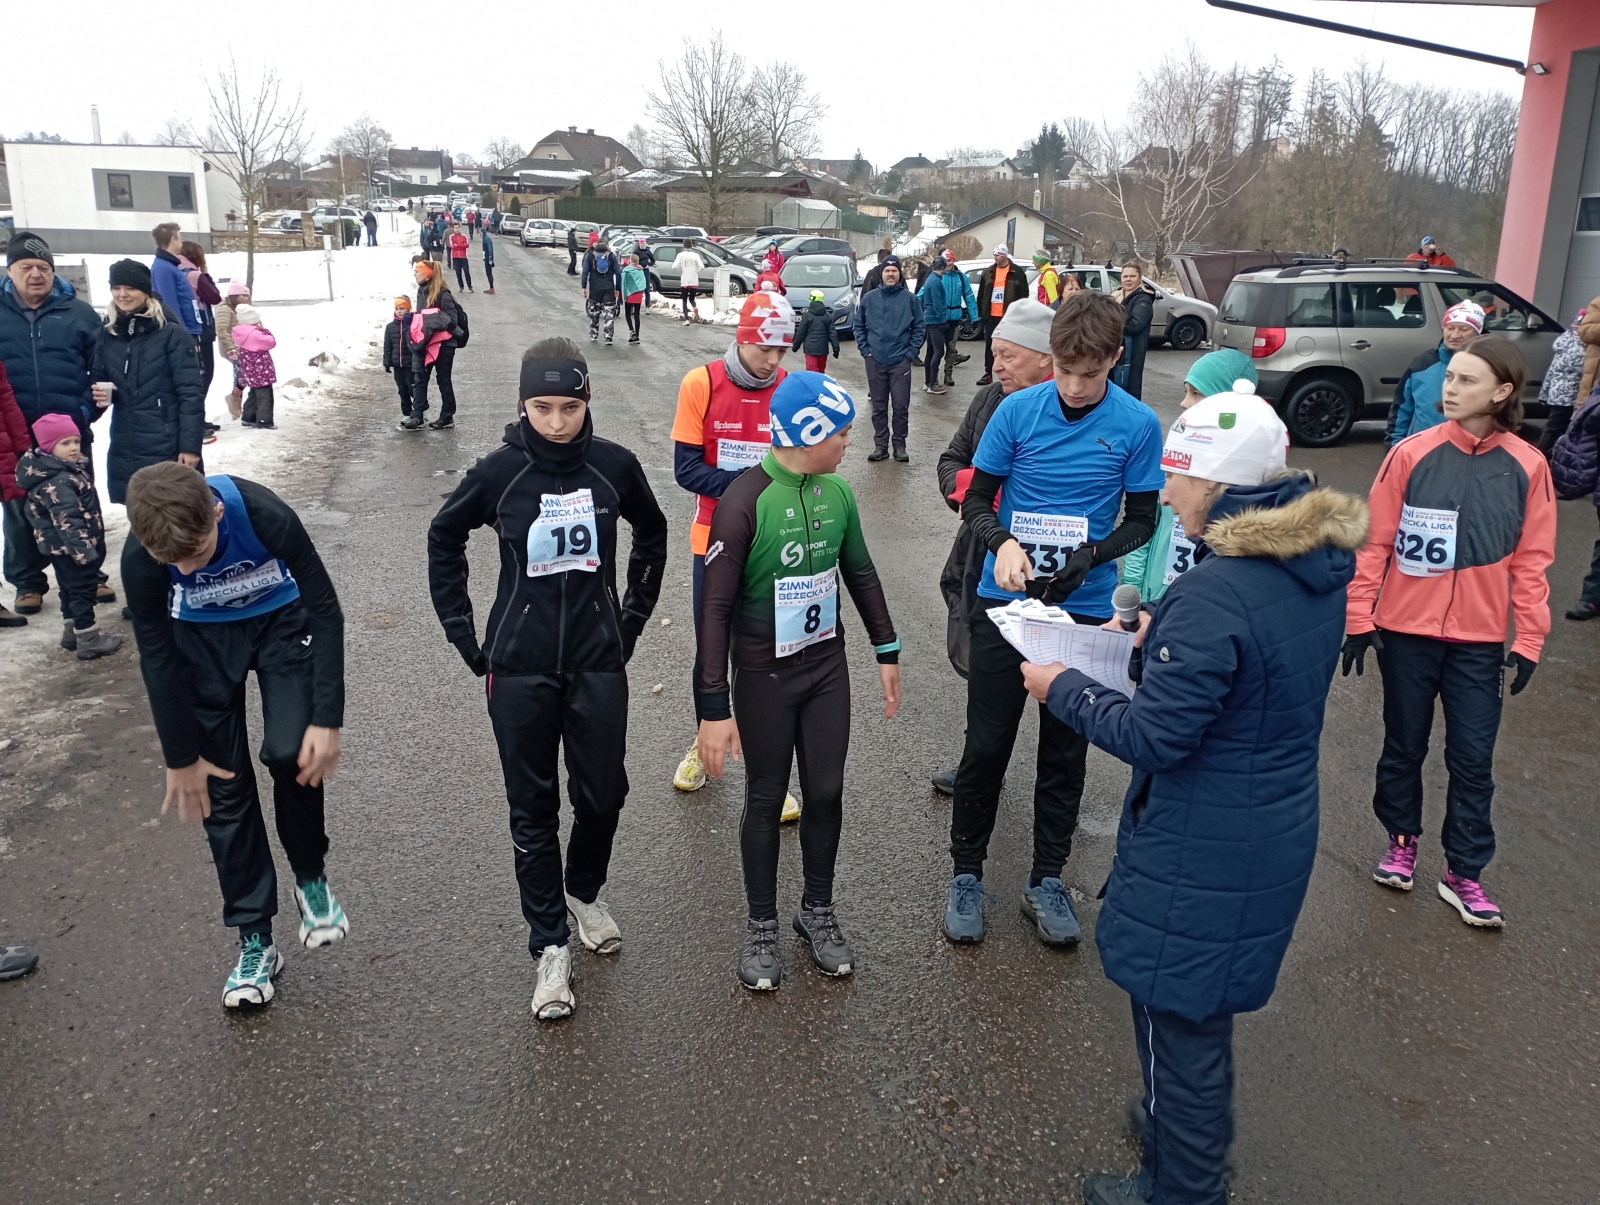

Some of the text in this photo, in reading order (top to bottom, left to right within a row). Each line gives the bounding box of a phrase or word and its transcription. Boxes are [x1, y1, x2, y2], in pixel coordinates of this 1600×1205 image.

[720, 441, 747, 452] ZIMNÍ
[719, 449, 759, 461] BĚŽECKÁ
[1014, 515, 1043, 527] ZIMNÍ
[1431, 522, 1454, 531] LIGA
[1012, 526, 1084, 539] BĚŽECKÁ LIGA
[550, 524, 592, 556] 19
[805, 540, 828, 551] SPORT
[1396, 528, 1448, 565] 326
[812, 546, 839, 559] MTB TEAM
[190, 584, 250, 605] BĚŽECKÁ
[251, 574, 280, 589] LIGA
[778, 579, 813, 591] ZIMNÍ
[778, 587, 824, 601] BĚŽECKÁ
[804, 603, 822, 634] 8
